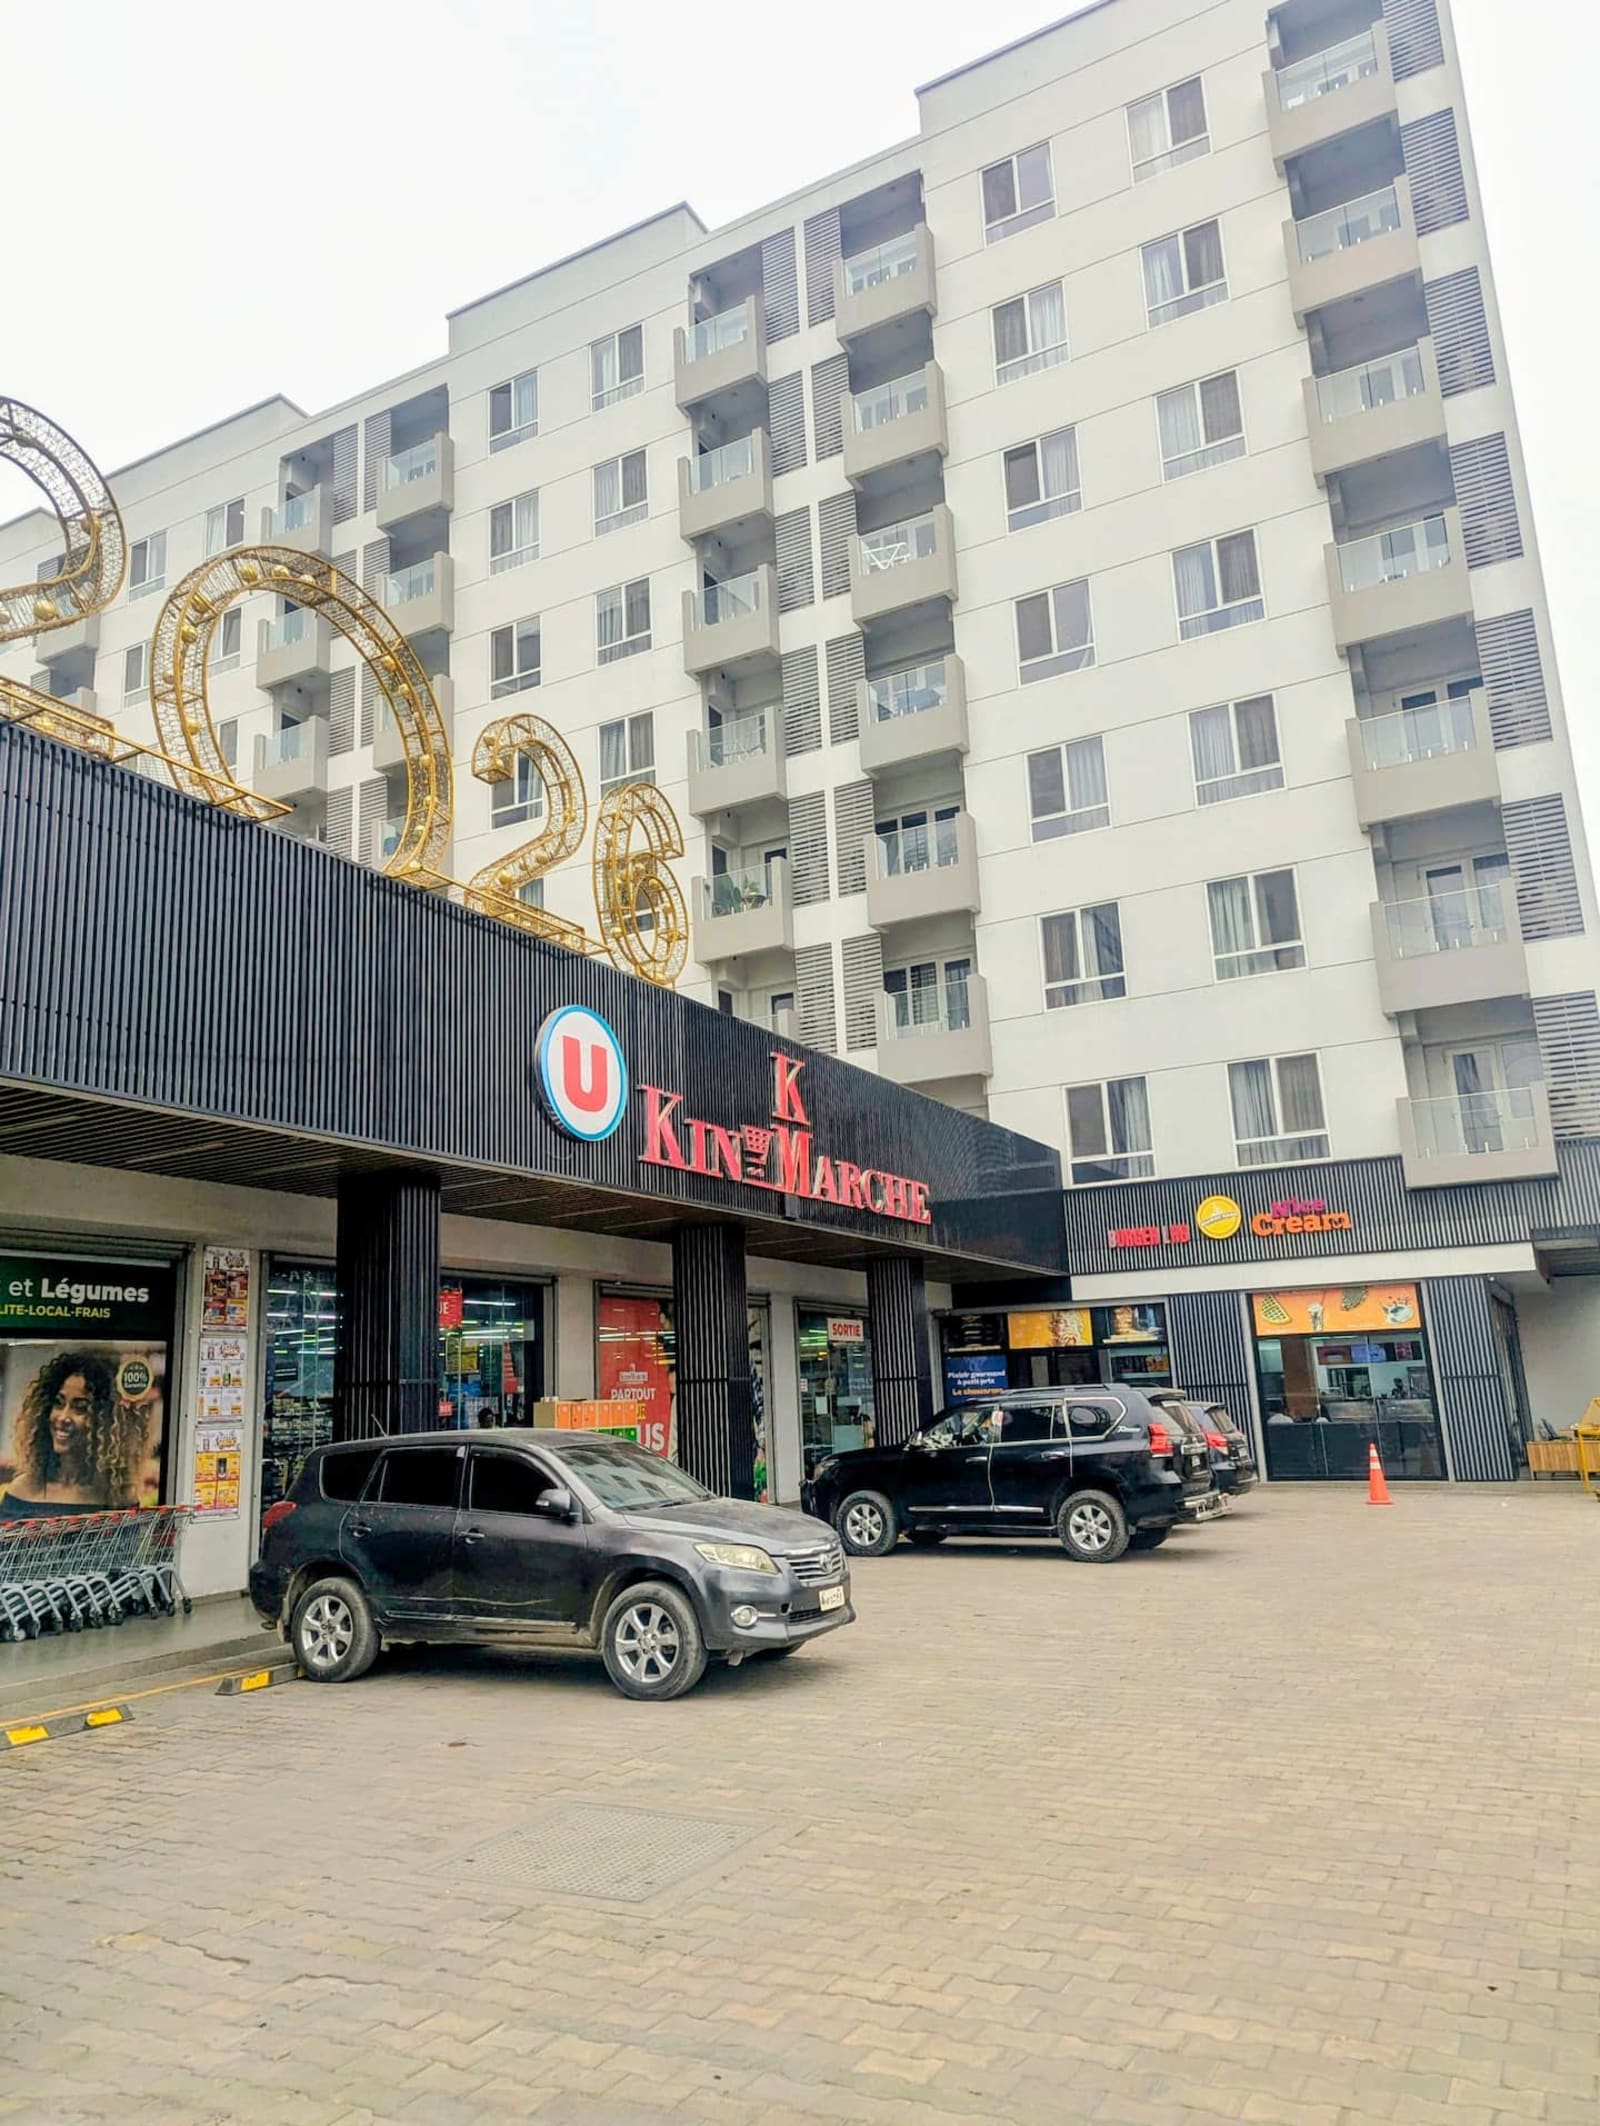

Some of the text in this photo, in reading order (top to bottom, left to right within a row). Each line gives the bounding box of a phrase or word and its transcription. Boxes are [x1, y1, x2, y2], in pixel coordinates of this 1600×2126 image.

[562, 1035, 608, 1113] U
[771, 1051, 812, 1126] K
[1252, 1211, 1352, 1236] Cream
[9, 1279, 34, 1298] et
[41, 1277, 150, 1304] Légumes
[831, 1323, 862, 1337] SORTIE
[124, 1371, 148, 1382] 100%
[610, 1387, 657, 1401] PARTOUT
